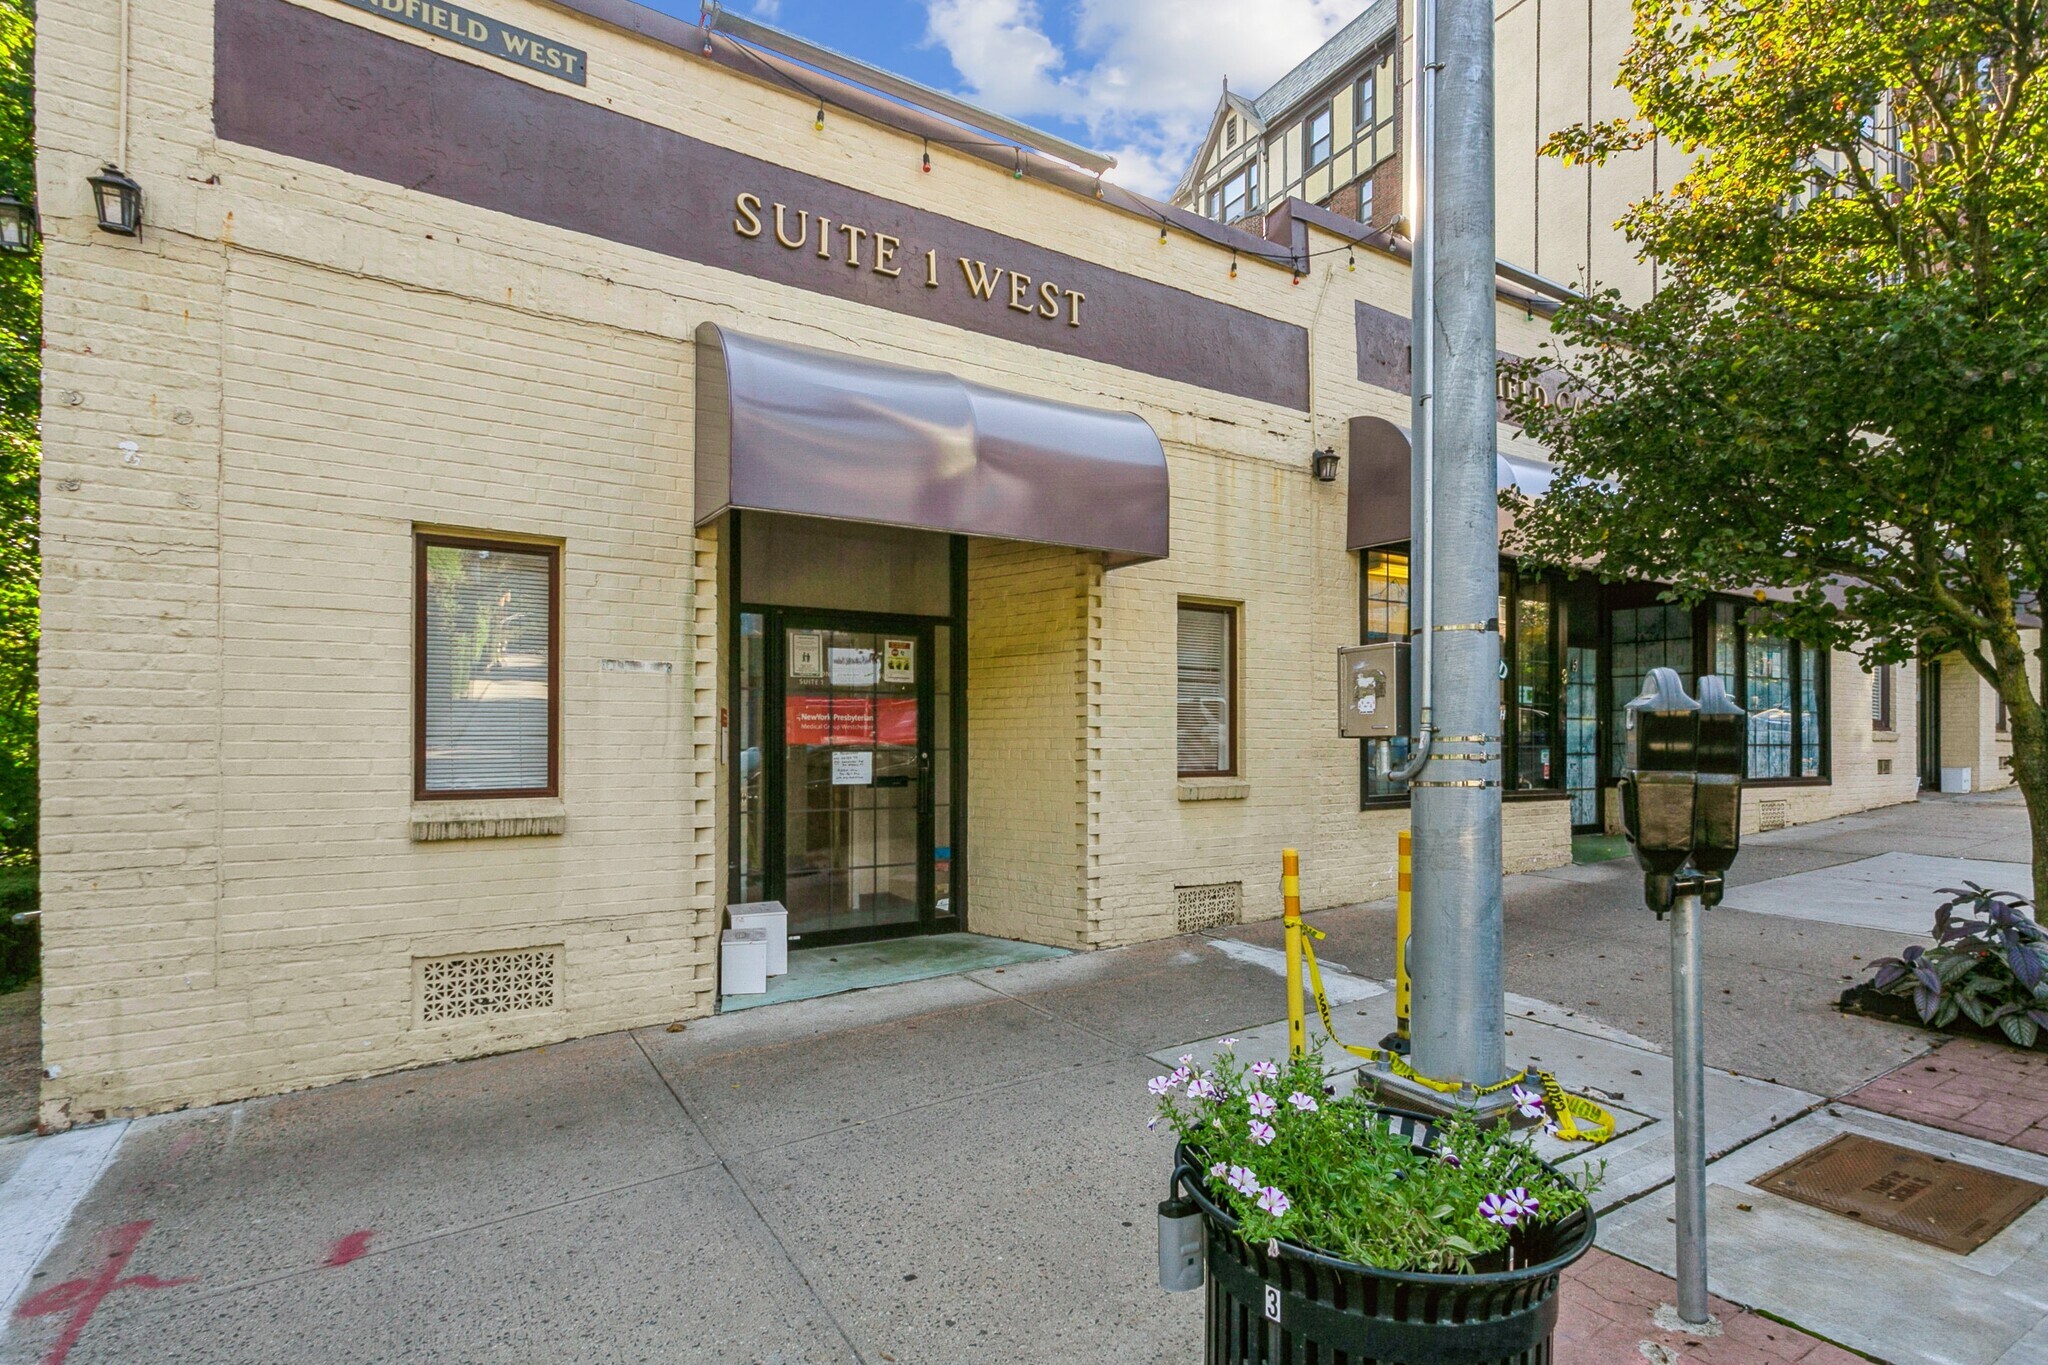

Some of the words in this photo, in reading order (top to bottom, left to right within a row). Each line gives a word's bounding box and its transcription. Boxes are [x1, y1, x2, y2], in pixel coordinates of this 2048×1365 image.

[500, 29, 578, 74] WEST
[733, 191, 902, 278] SUITE
[924, 248, 939, 288] 1
[958, 256, 1086, 327] WEST
[799, 678, 819, 686] SUITE
[1268, 1290, 1278, 1318] 3
